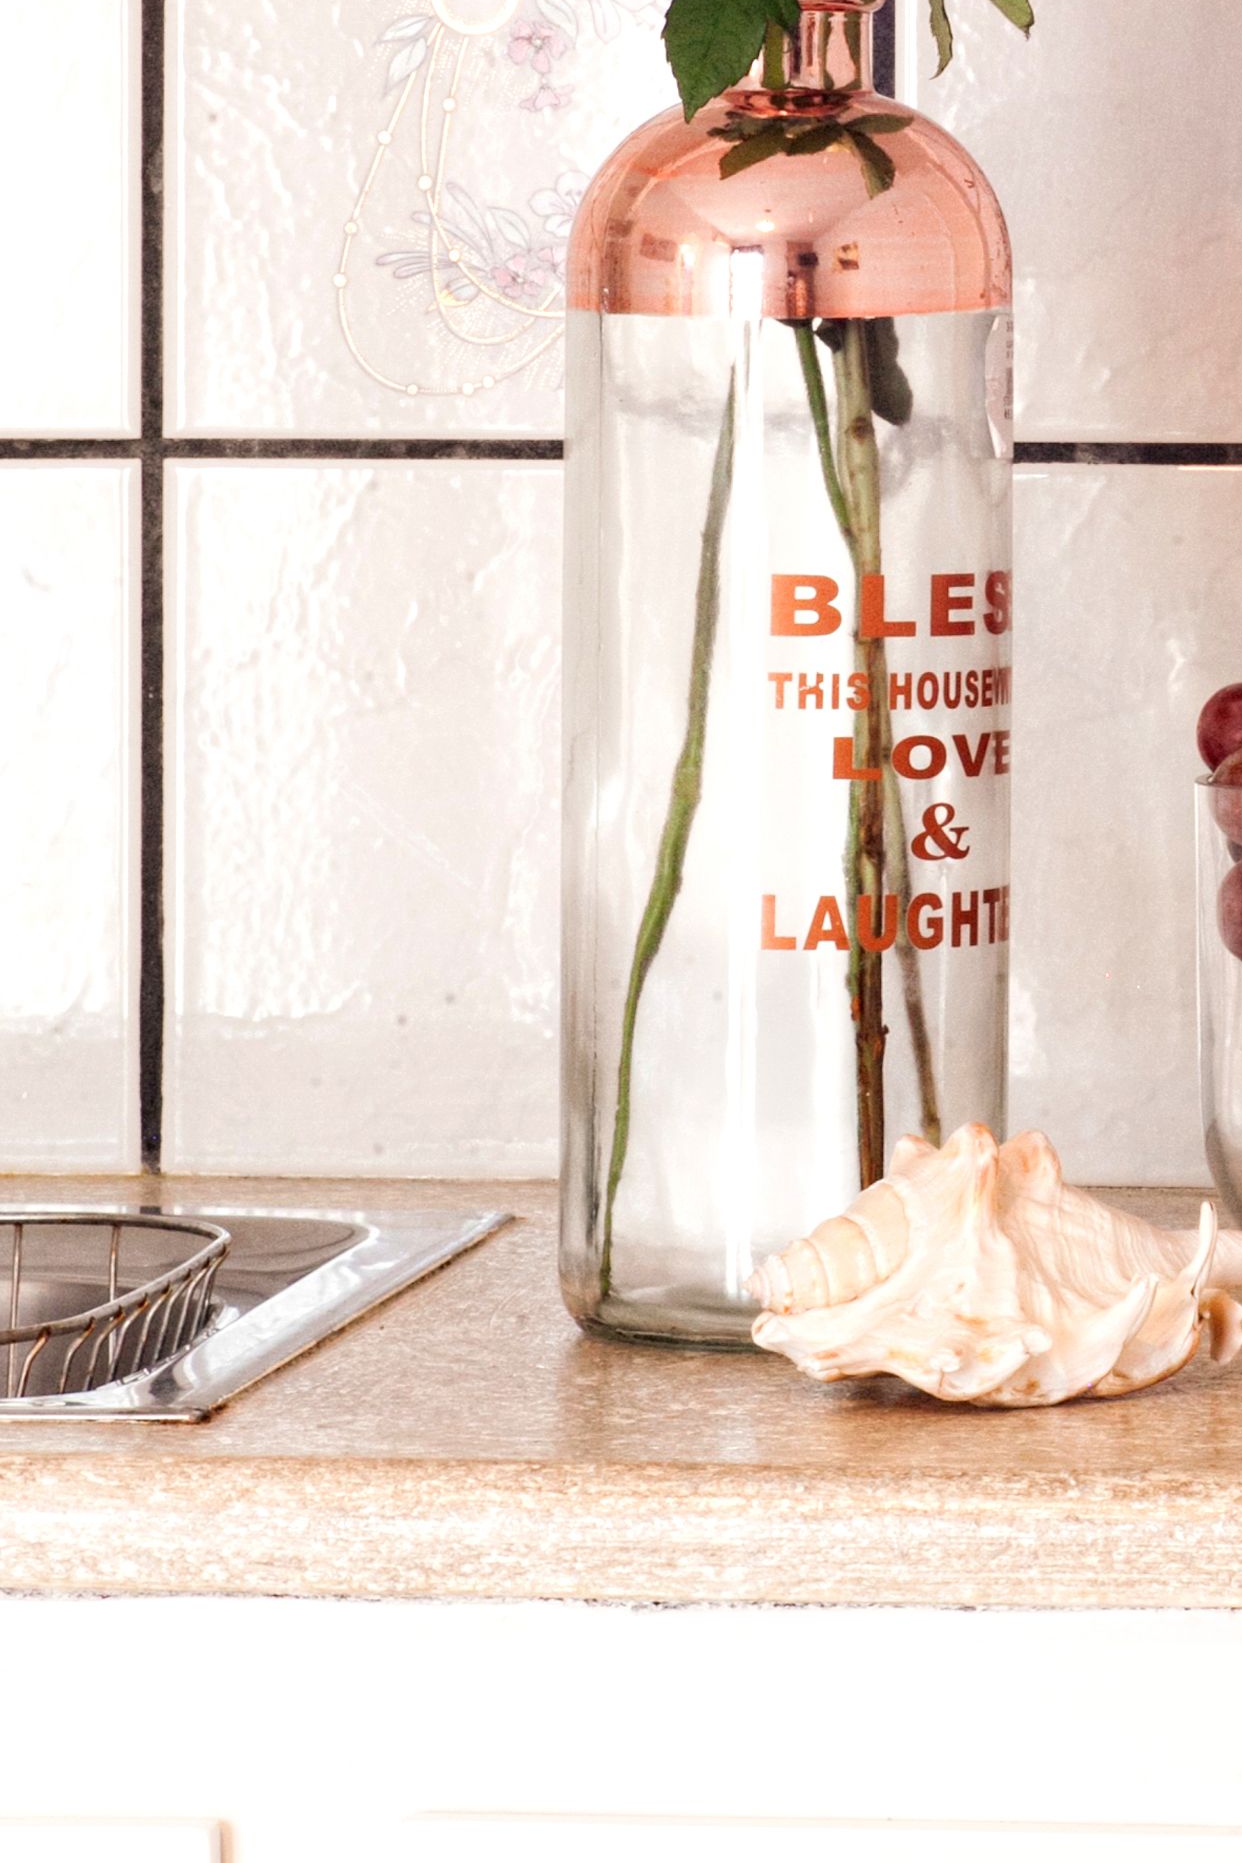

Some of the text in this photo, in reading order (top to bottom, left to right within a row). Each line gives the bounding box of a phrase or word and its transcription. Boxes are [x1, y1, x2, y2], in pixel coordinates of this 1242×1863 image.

[771, 570, 1012, 637] BLES
[768, 671, 871, 711] THIS
[889, 669, 993, 710] HOUSE
[833, 730, 1011, 780] LOVE
[910, 802, 970, 861] &
